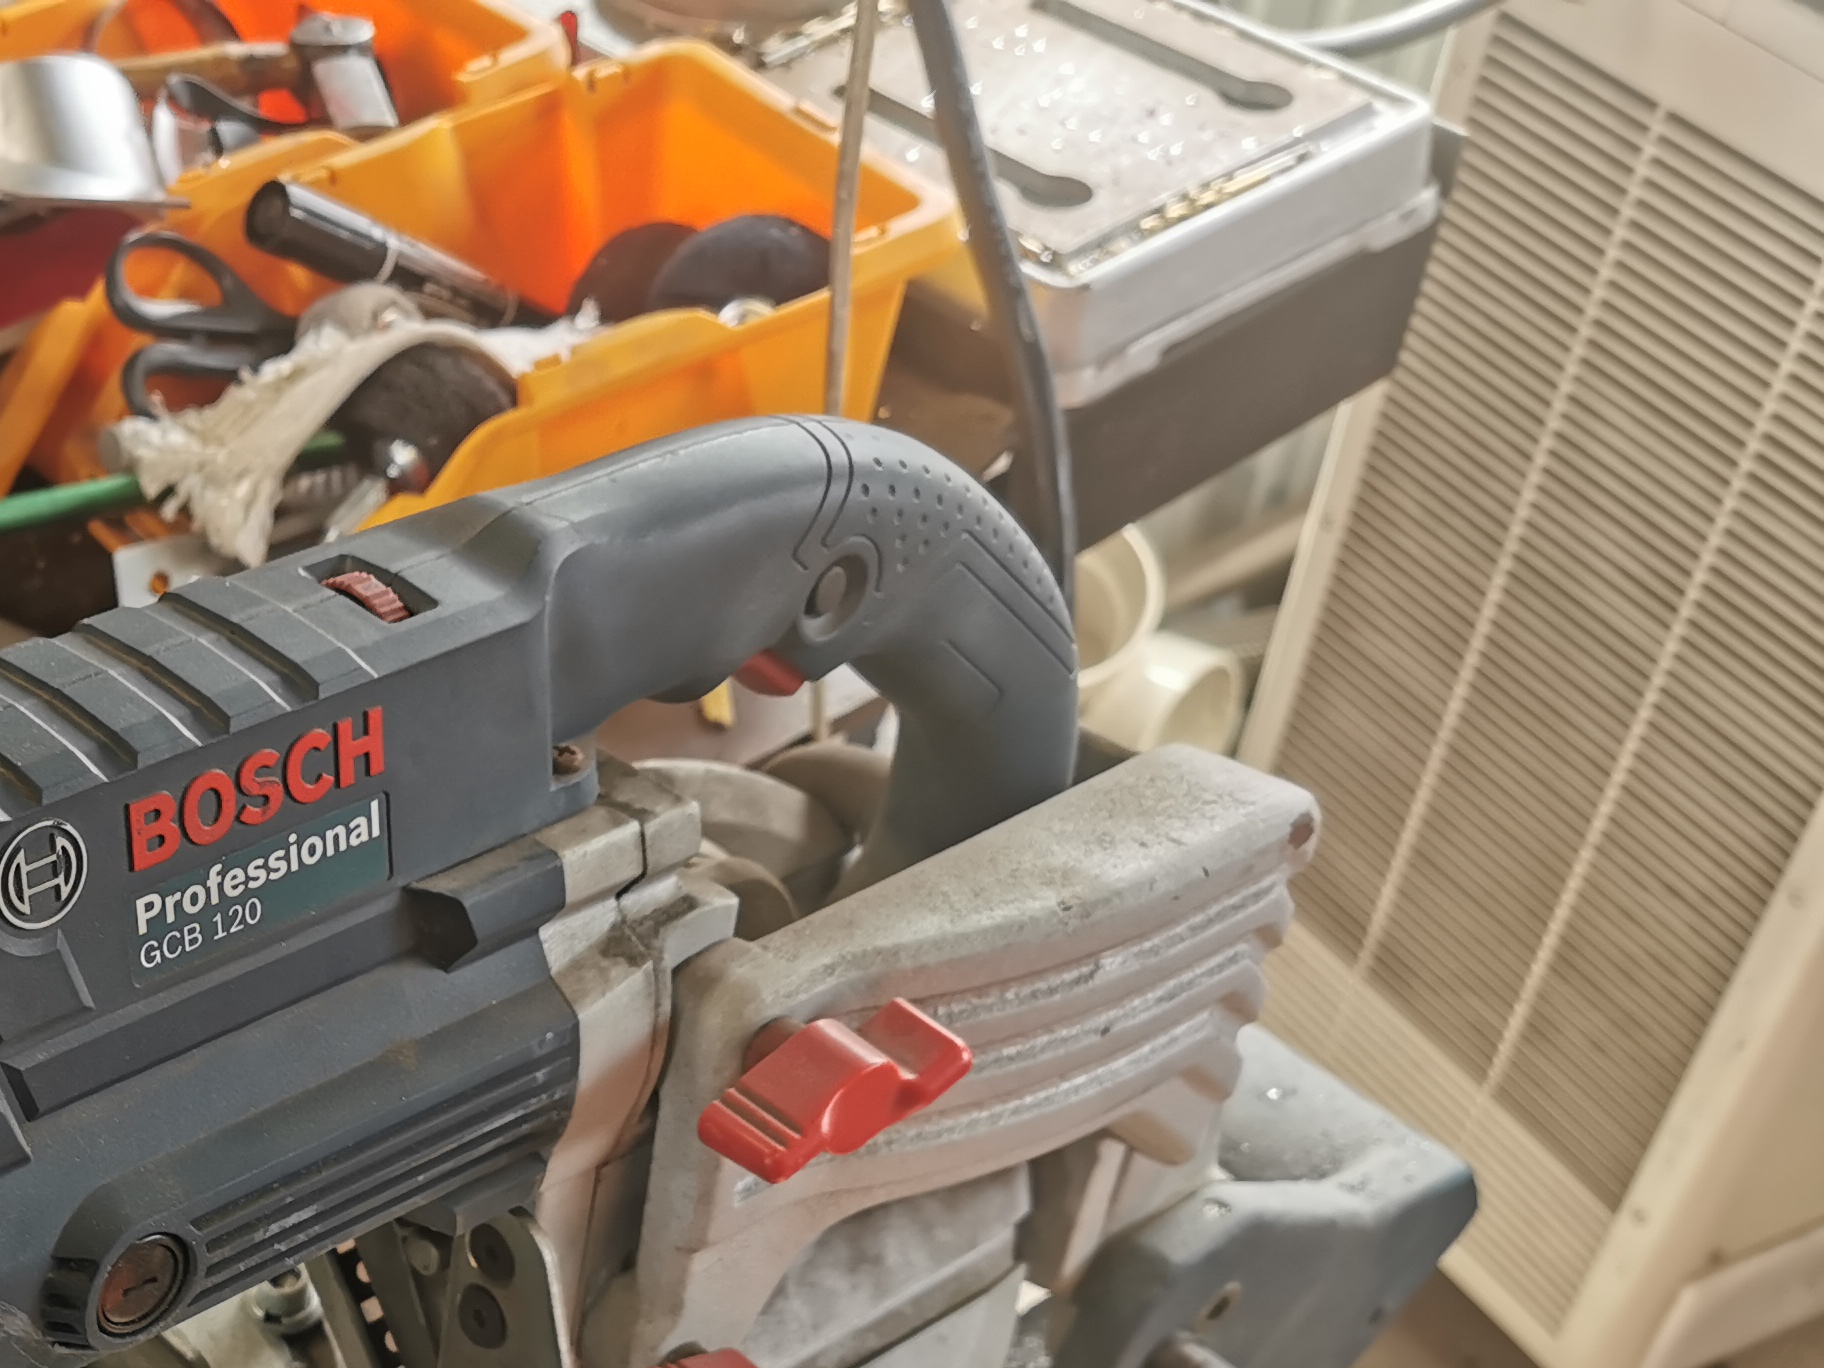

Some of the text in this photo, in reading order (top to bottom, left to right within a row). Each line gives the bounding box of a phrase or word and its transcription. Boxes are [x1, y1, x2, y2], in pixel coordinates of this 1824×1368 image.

[127, 706, 385, 872] BOSCH
[135, 799, 381, 936] Professional
[139, 897, 262, 968] GCB 120
